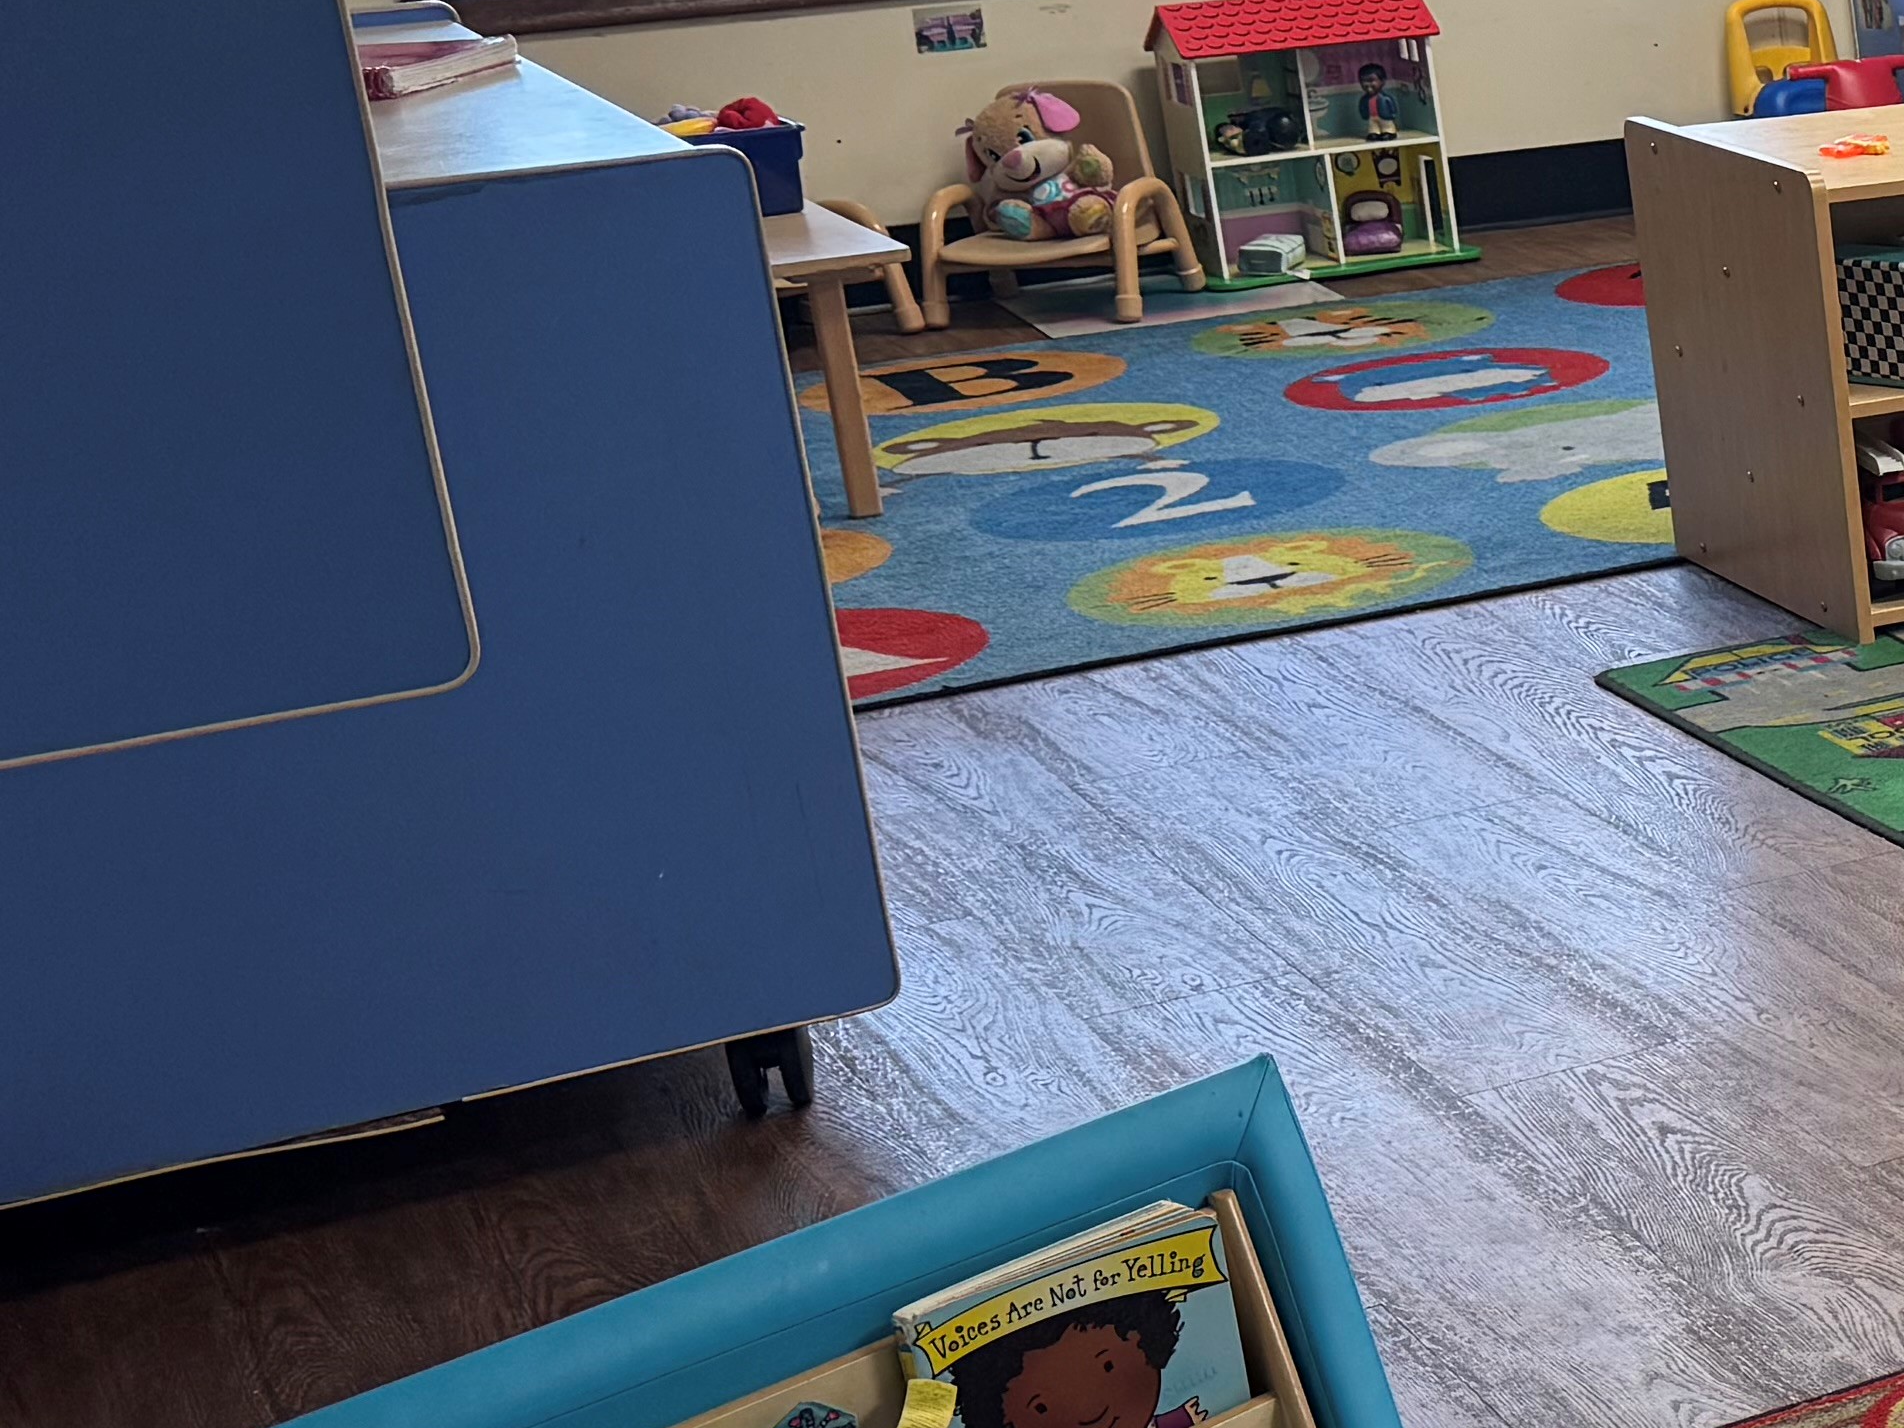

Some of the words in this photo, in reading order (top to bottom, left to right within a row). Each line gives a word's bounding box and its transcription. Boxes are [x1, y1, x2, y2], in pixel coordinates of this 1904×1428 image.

[1071, 471, 1257, 529] 2
[929, 1311, 1001, 1360] Voices
[1006, 1297, 1045, 1325] Are
[1050, 1274, 1088, 1309] Not
[1093, 1269, 1121, 1293] for
[1119, 1250, 1207, 1282] Yelling
